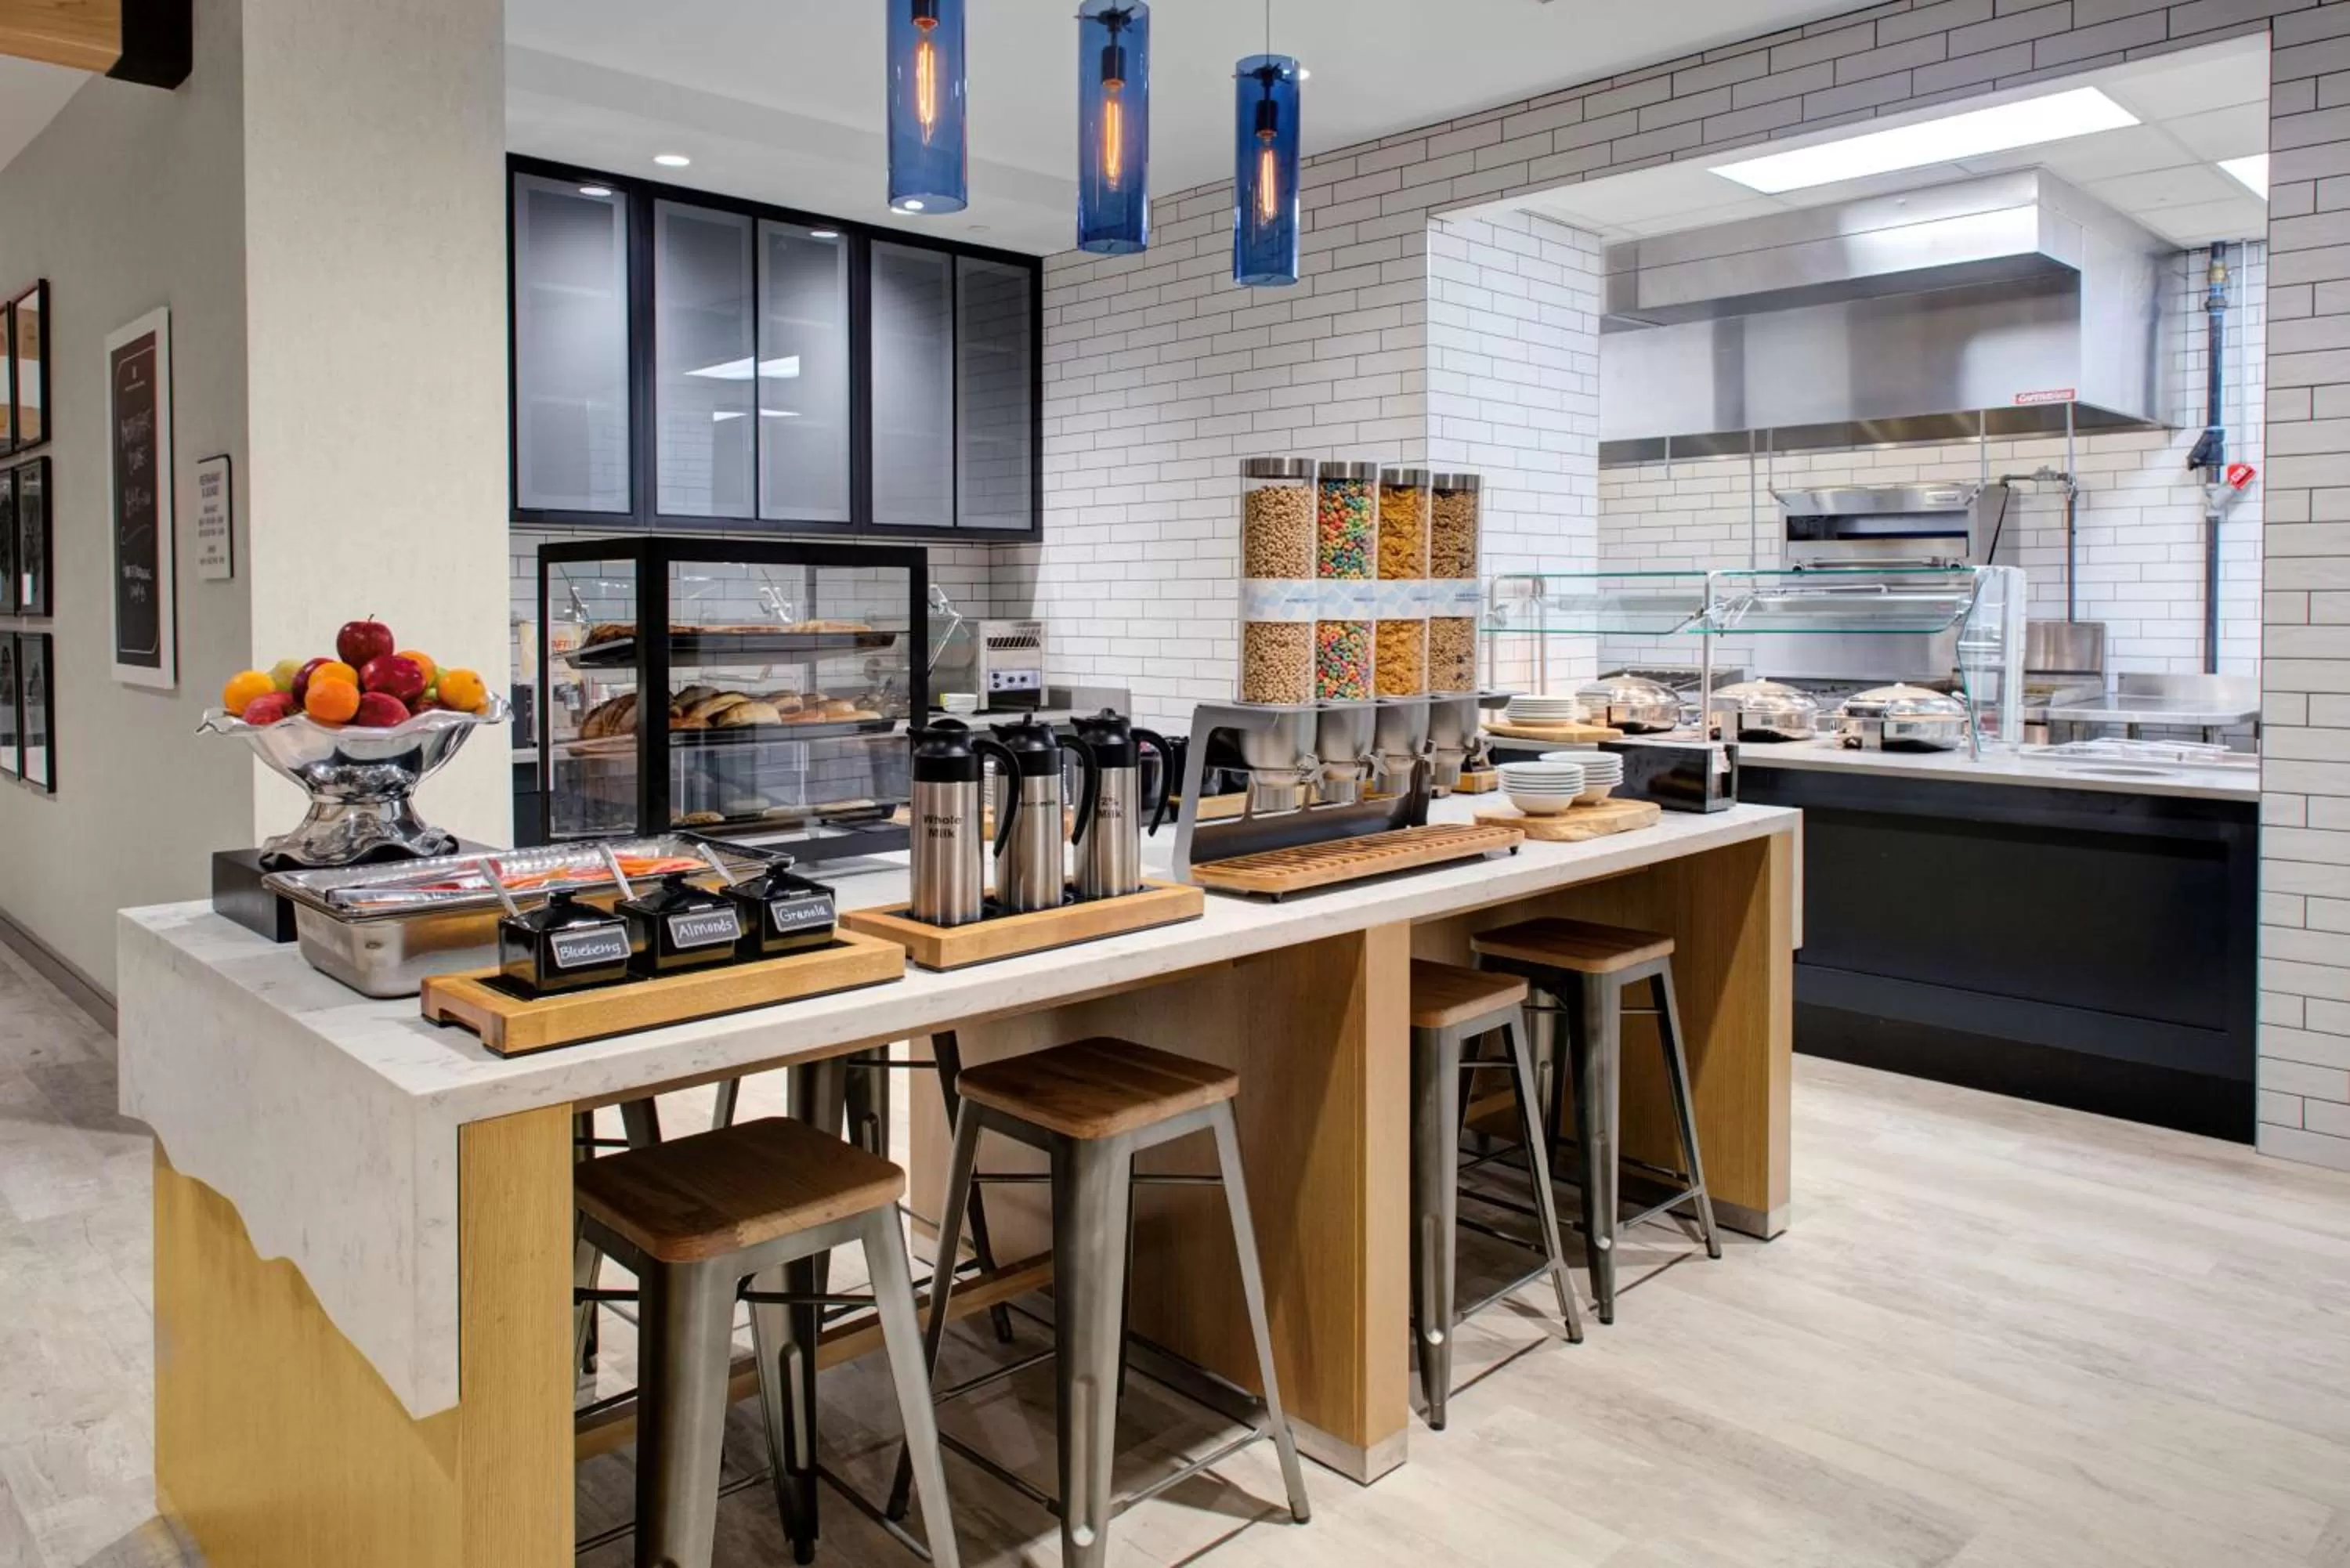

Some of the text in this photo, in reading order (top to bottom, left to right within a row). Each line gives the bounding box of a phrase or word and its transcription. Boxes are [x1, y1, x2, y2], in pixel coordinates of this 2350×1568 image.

[924, 814, 964, 825] Whole
[928, 828, 955, 839] Milk
[779, 904, 828, 923] Granola
[678, 917, 732, 939] Almonds
[559, 941, 621, 961] Blueberry
